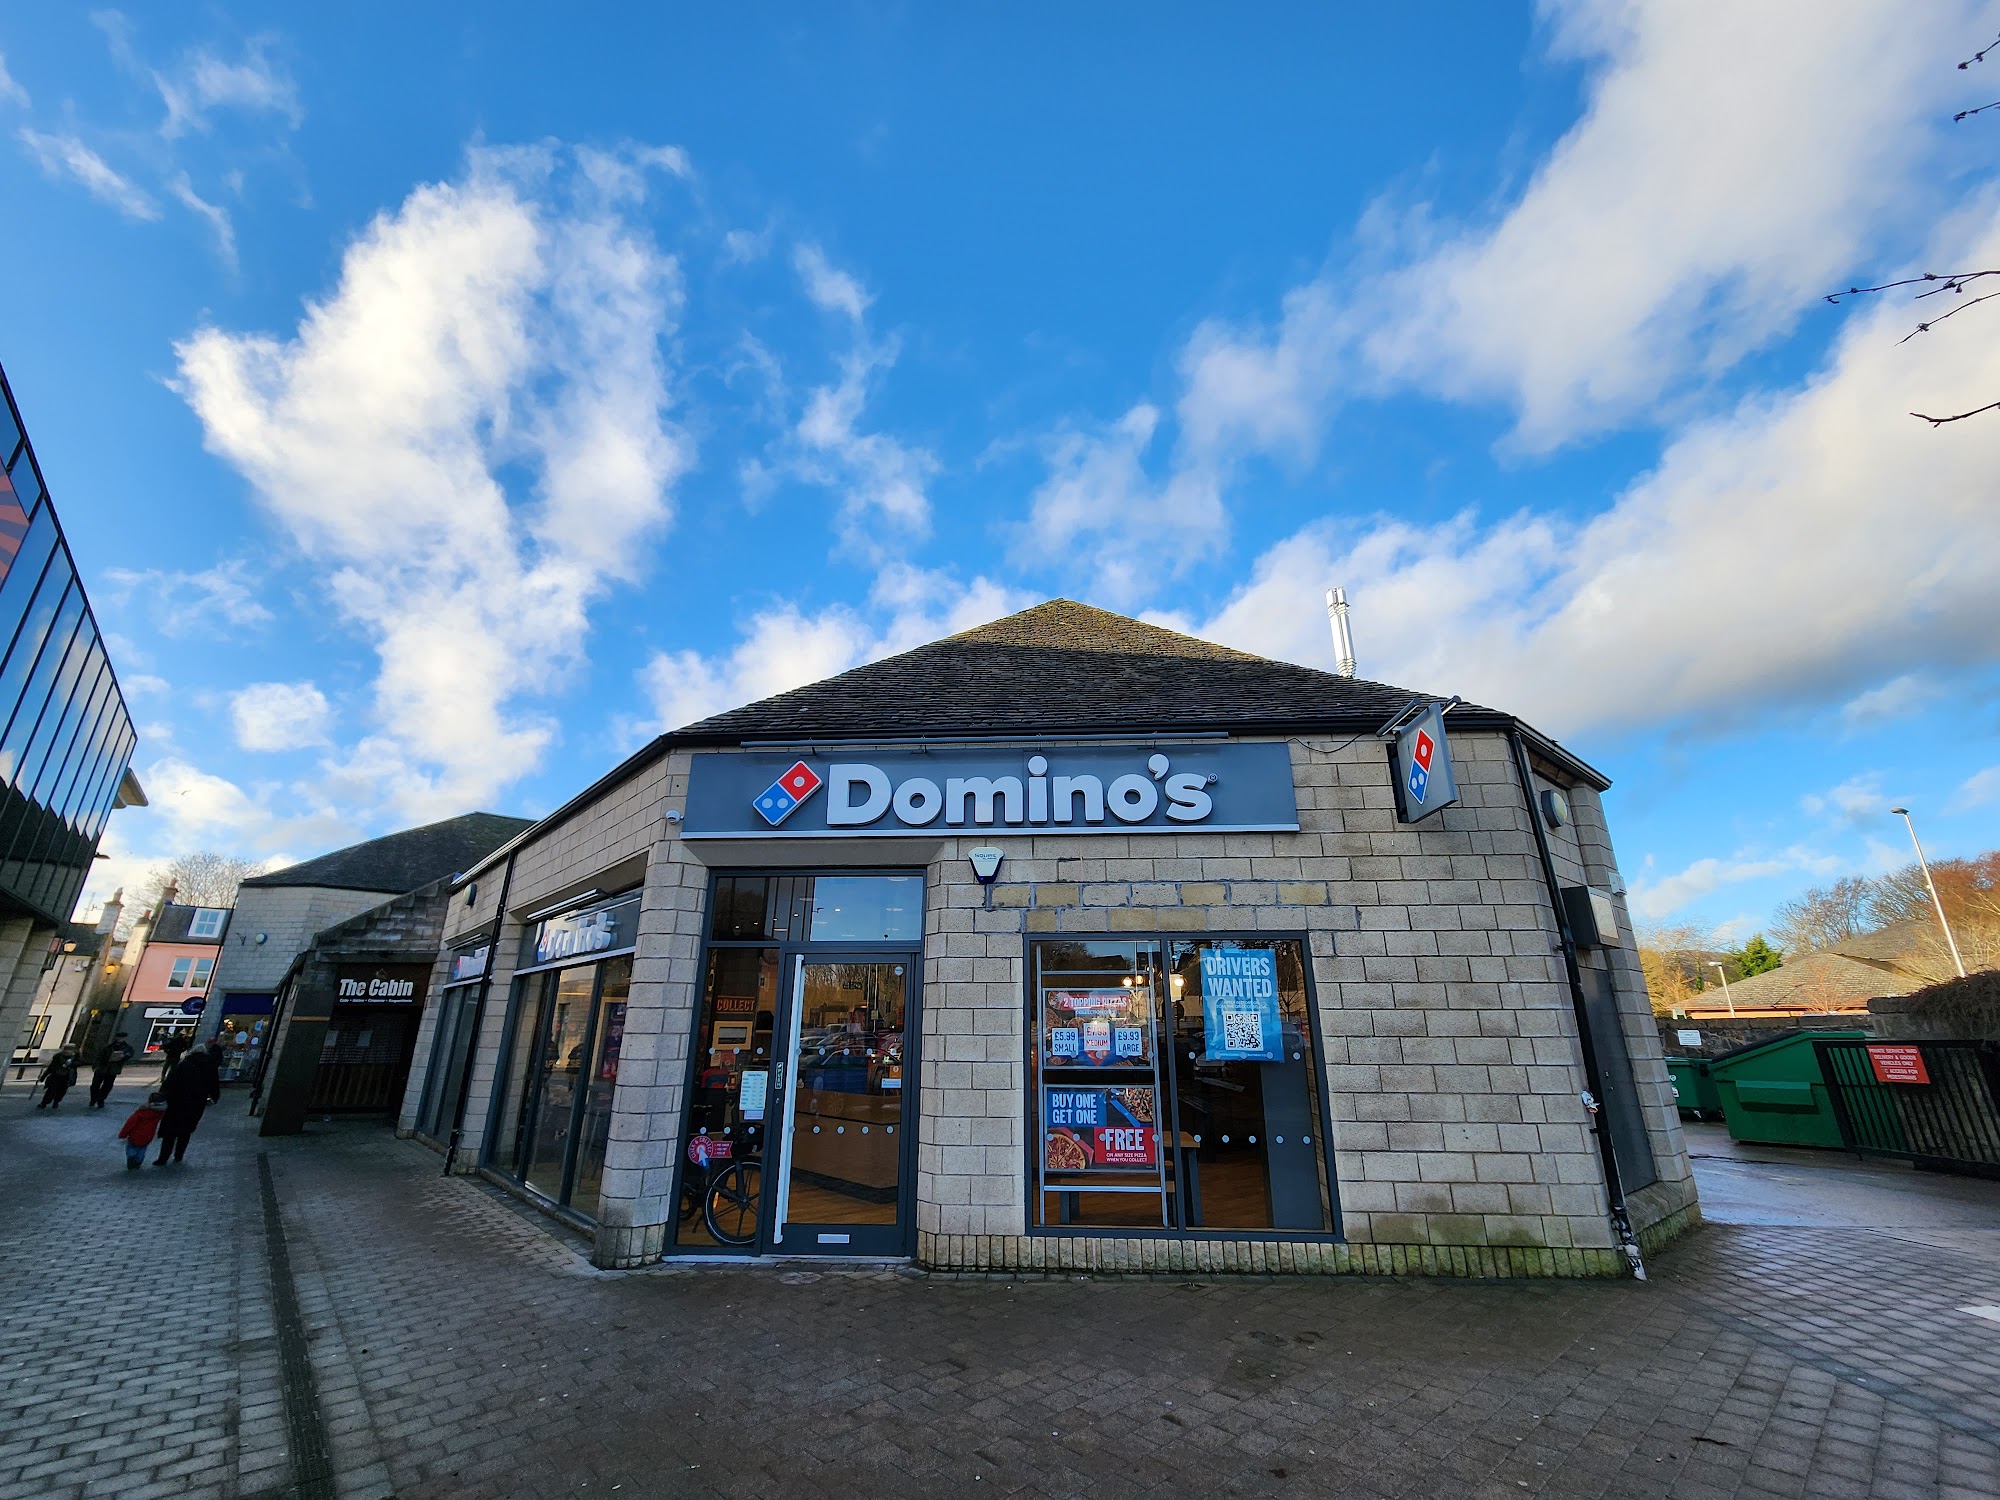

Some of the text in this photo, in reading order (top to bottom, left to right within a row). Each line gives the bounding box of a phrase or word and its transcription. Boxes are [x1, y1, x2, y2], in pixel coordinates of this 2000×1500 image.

[826, 753, 1214, 826] Domino's
[1205, 957, 1270, 976] DRIVERS
[339, 978, 414, 996] The Cabin
[1207, 977, 1272, 998] WANTED
[716, 1000, 756, 1012] COLLECT
[1063, 997, 1127, 1007] 2 TOPPING PIZZAS
[1054, 1031, 1076, 1041] £5.99
[1086, 1039, 1108, 1047] MEDIUM
[1054, 1043, 1076, 1052] SMALL
[1118, 1043, 1140, 1052] LARGE
[1052, 1093, 1097, 1109] BUY ONE
[1052, 1109, 1097, 1125] GET ONE
[1104, 1128, 1145, 1151] FREE
